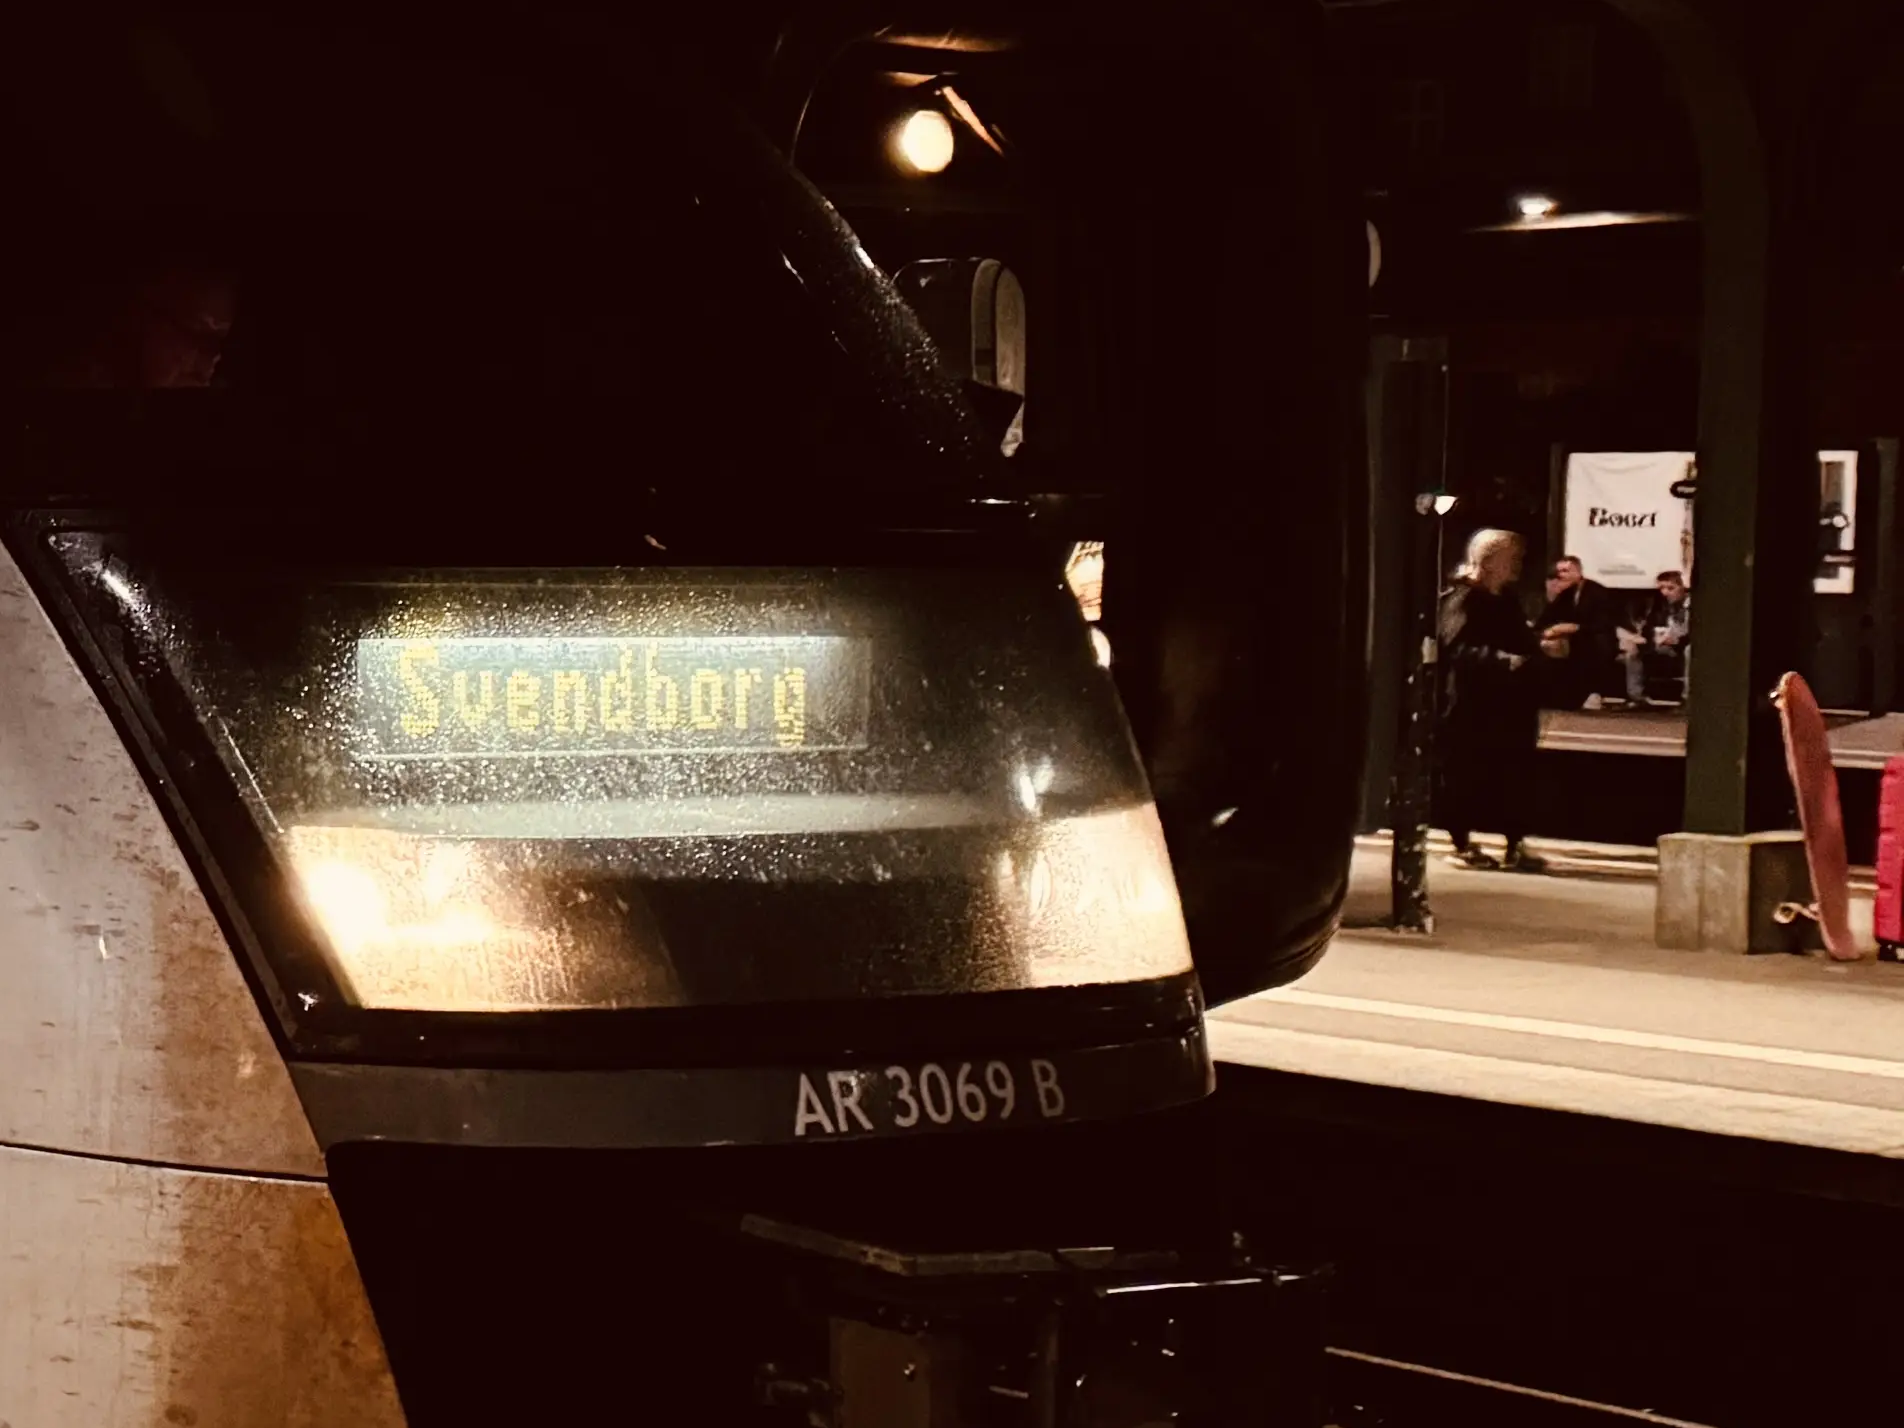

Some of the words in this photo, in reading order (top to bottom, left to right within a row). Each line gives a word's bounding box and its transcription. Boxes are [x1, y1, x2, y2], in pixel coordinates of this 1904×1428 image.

[398, 642, 808, 748] Svendborg
[795, 1069, 874, 1137] AR
[884, 1060, 1015, 1128] 3069
[1031, 1058, 1065, 1118] B
